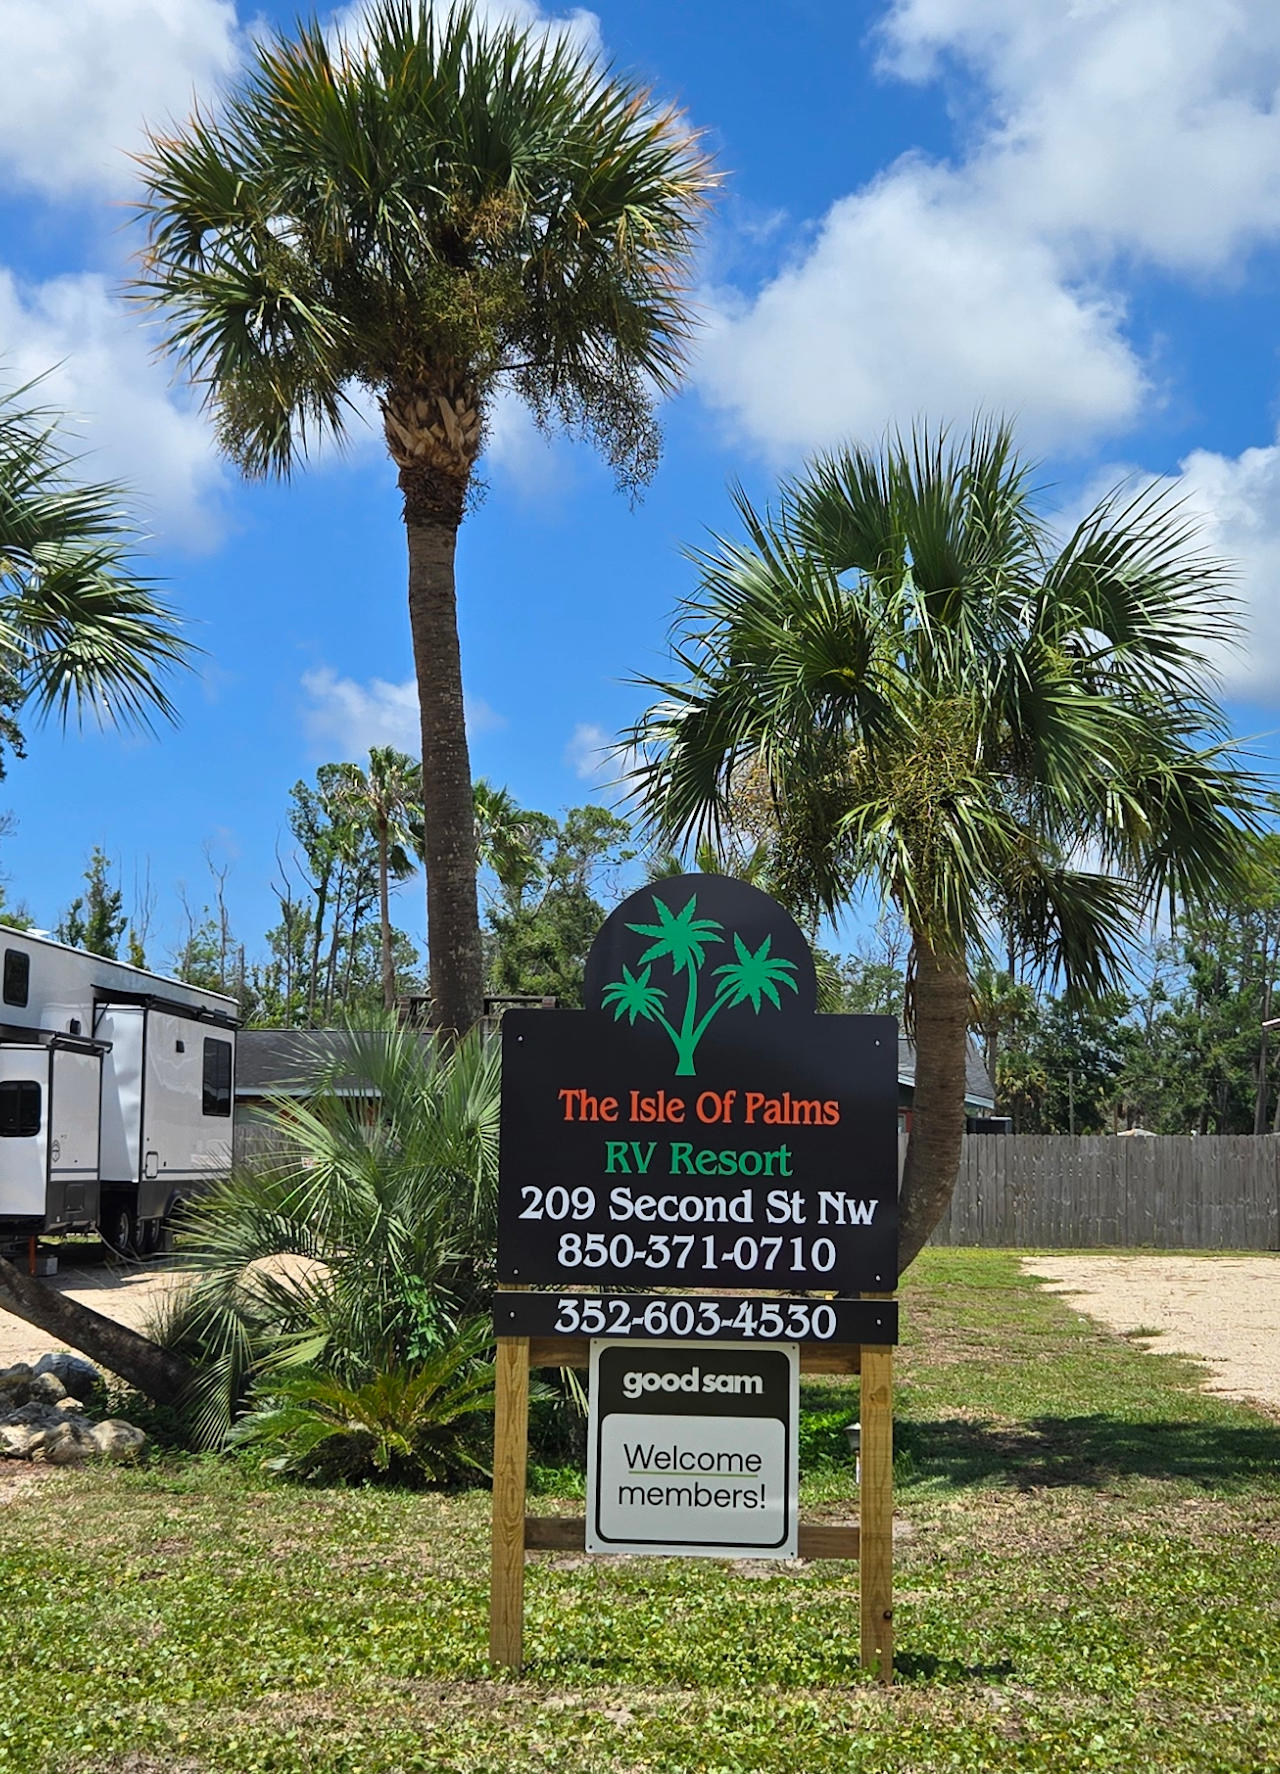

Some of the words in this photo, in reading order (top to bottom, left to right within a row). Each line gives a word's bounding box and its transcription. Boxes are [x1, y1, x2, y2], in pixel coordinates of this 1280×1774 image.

[559, 1089, 618, 1121] The
[629, 1090, 685, 1123] Isle
[696, 1090, 736, 1123] Of
[744, 1092, 840, 1125] Palms
[605, 1142, 657, 1173] RV
[670, 1143, 793, 1176] Resort
[518, 1186, 595, 1220] 209
[609, 1187, 754, 1222] Second
[766, 1190, 806, 1224] St
[818, 1191, 878, 1225] Nw
[558, 1233, 836, 1271] 850-371-0710
[554, 1299, 837, 1339] 352-603-4530
[624, 1444, 761, 1472] Welcome
[619, 1482, 765, 1508] members!
